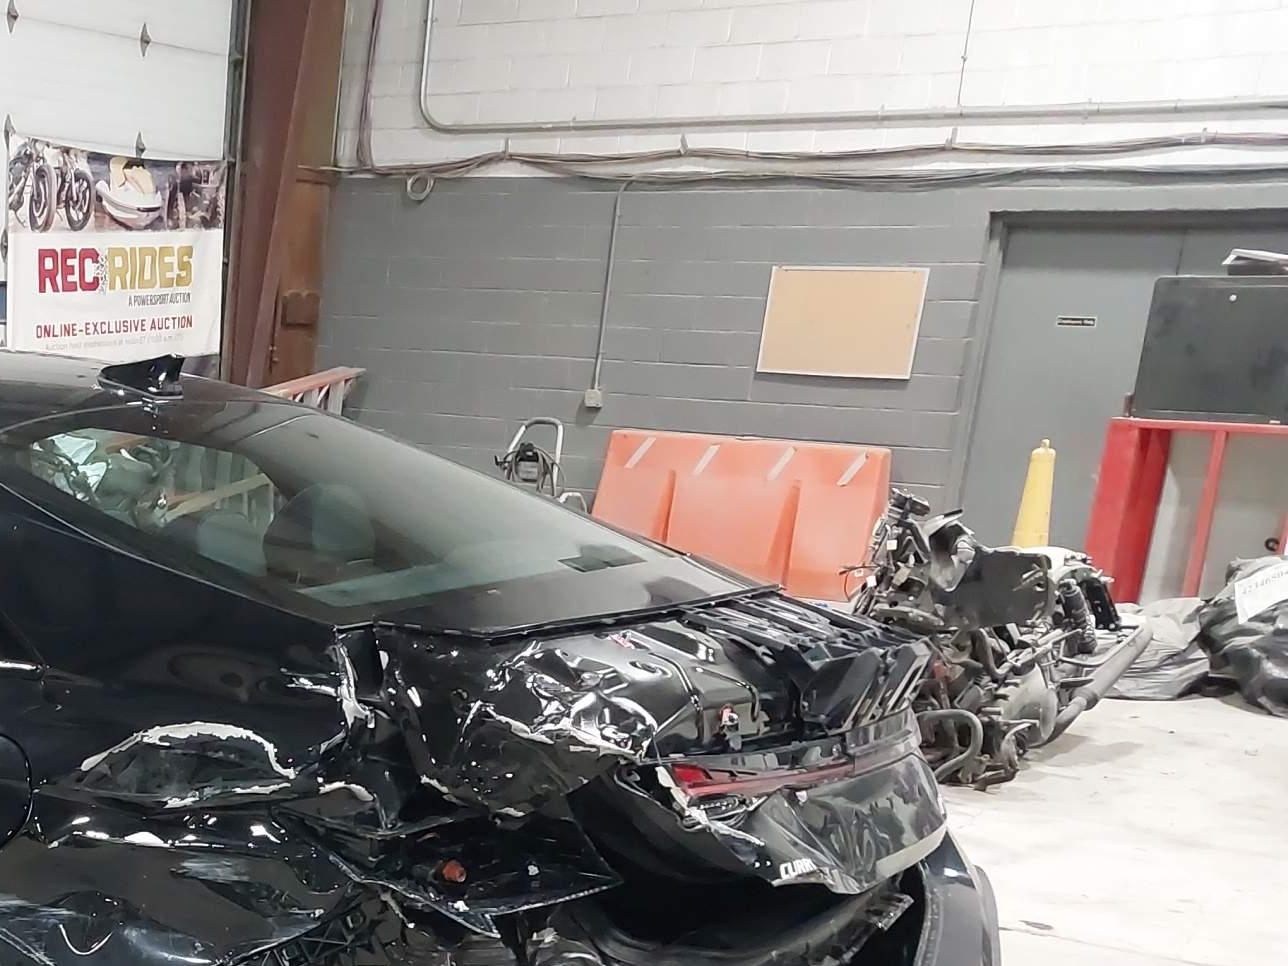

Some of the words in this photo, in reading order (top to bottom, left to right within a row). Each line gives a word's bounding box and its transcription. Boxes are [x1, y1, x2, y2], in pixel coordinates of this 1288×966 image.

[38, 248, 99, 293] REC
[108, 246, 193, 290] RIDES
[128, 295, 133, 307] A
[133, 293, 169, 307] POWERSPORT
[169, 292, 191, 305] AUCTION
[36, 317, 147, 339] ONLINE-EXCLUSIVE
[150, 314, 193, 330] AUCTION
